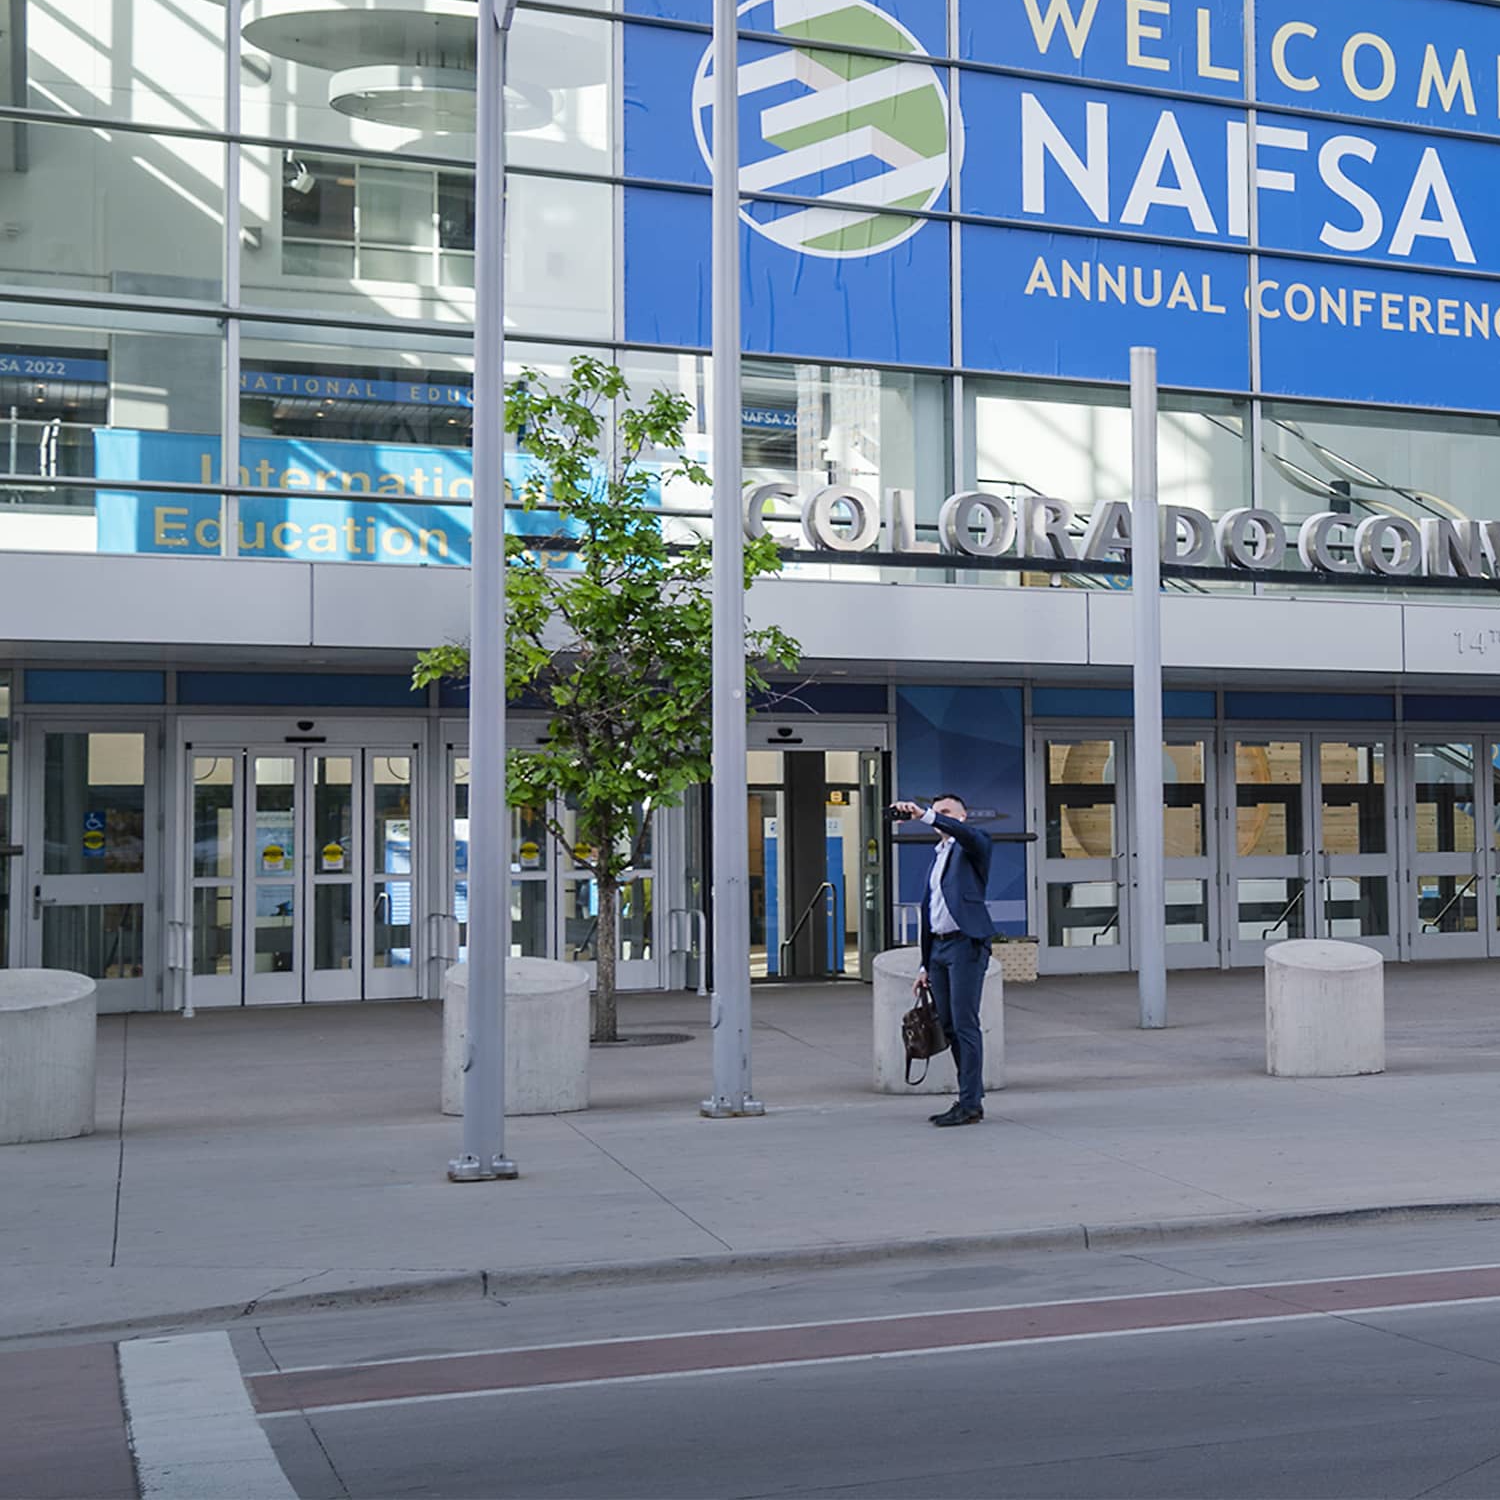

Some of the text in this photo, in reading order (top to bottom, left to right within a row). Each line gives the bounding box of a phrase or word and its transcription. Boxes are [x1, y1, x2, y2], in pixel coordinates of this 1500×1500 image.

[1021, 92, 1476, 264] NAFSA
[1023, 256, 1227, 315] ANNUAL
[24, 359, 66, 376] 2022
[740, 411, 782, 425] NAFSA
[154, 506, 449, 558] Education
[743, 482, 1286, 570] COLORADO
